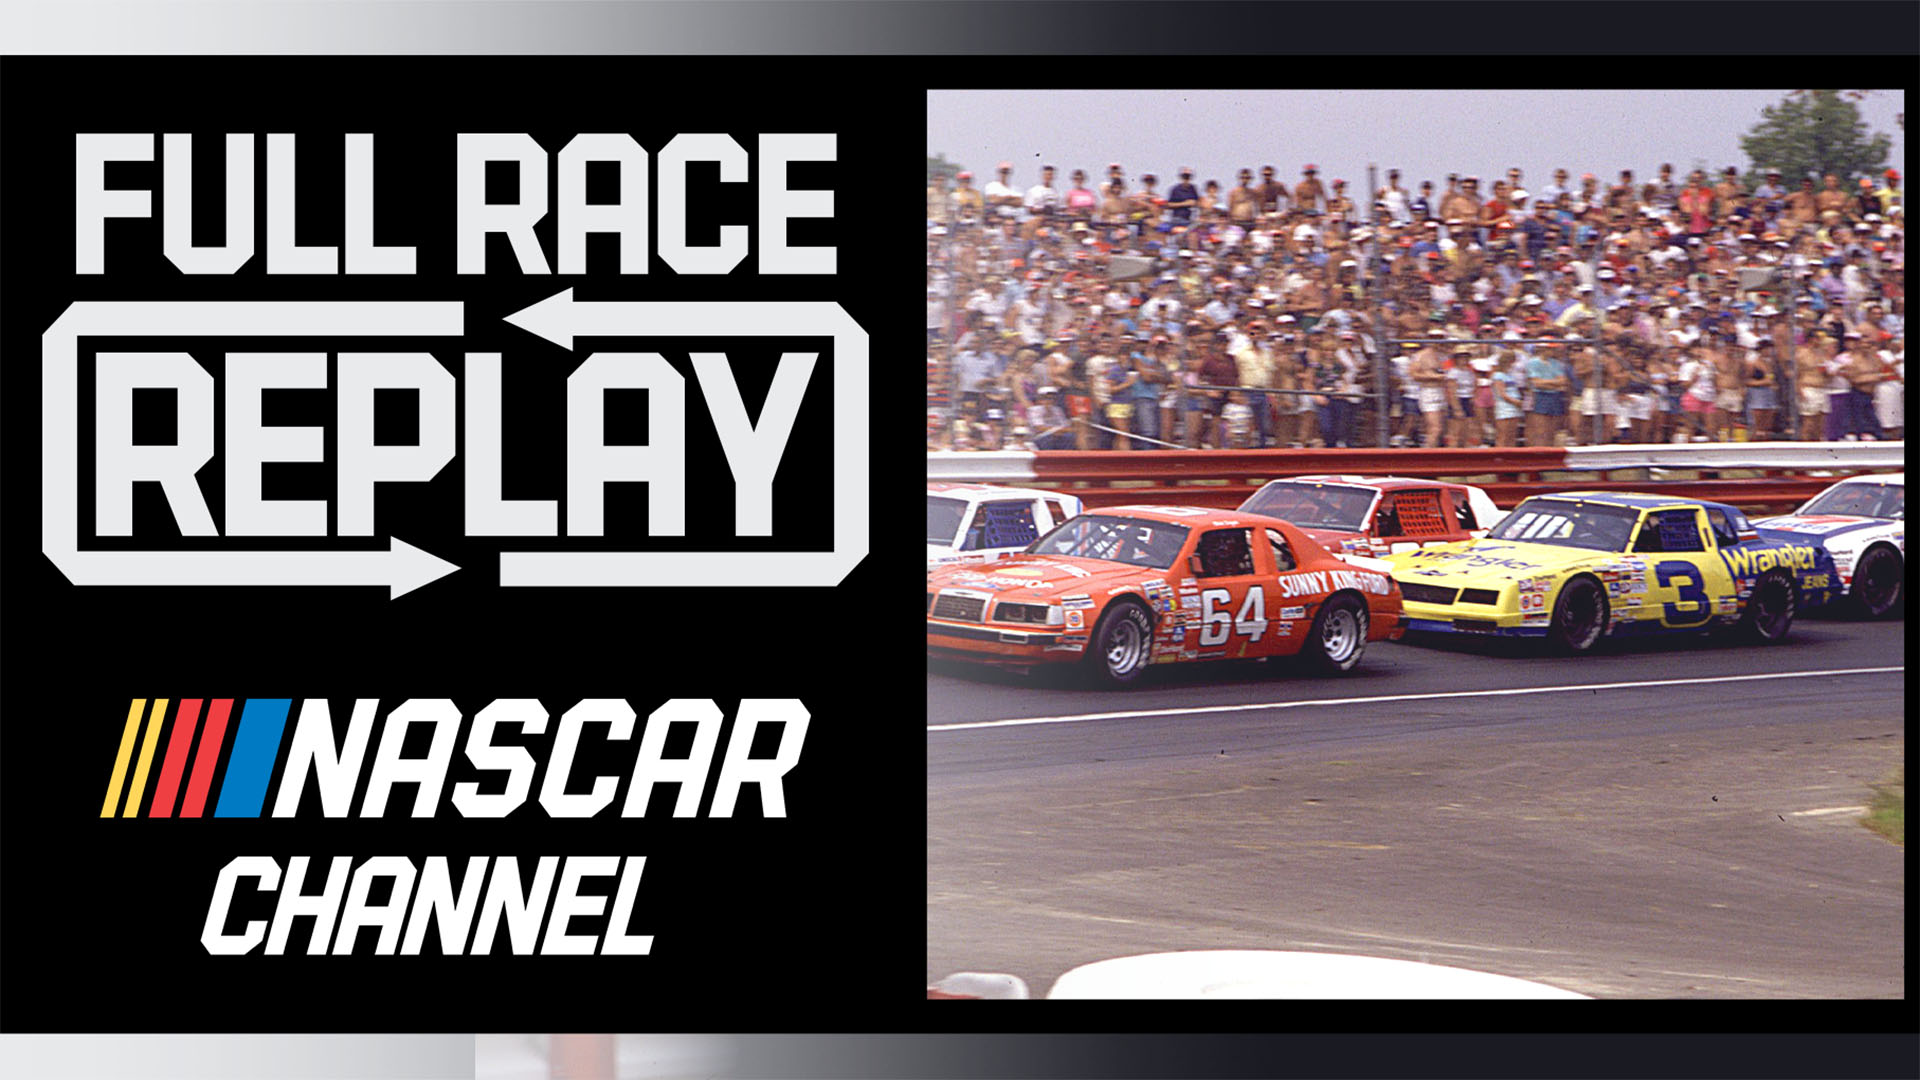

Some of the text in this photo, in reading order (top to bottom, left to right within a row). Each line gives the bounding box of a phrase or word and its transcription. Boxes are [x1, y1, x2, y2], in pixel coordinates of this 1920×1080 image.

[1278, 570, 1330, 598] SUNNY
[1720, 543, 1816, 578] Wrangler
[1199, 585, 1269, 647] 64
[1654, 560, 1711, 627] 3
